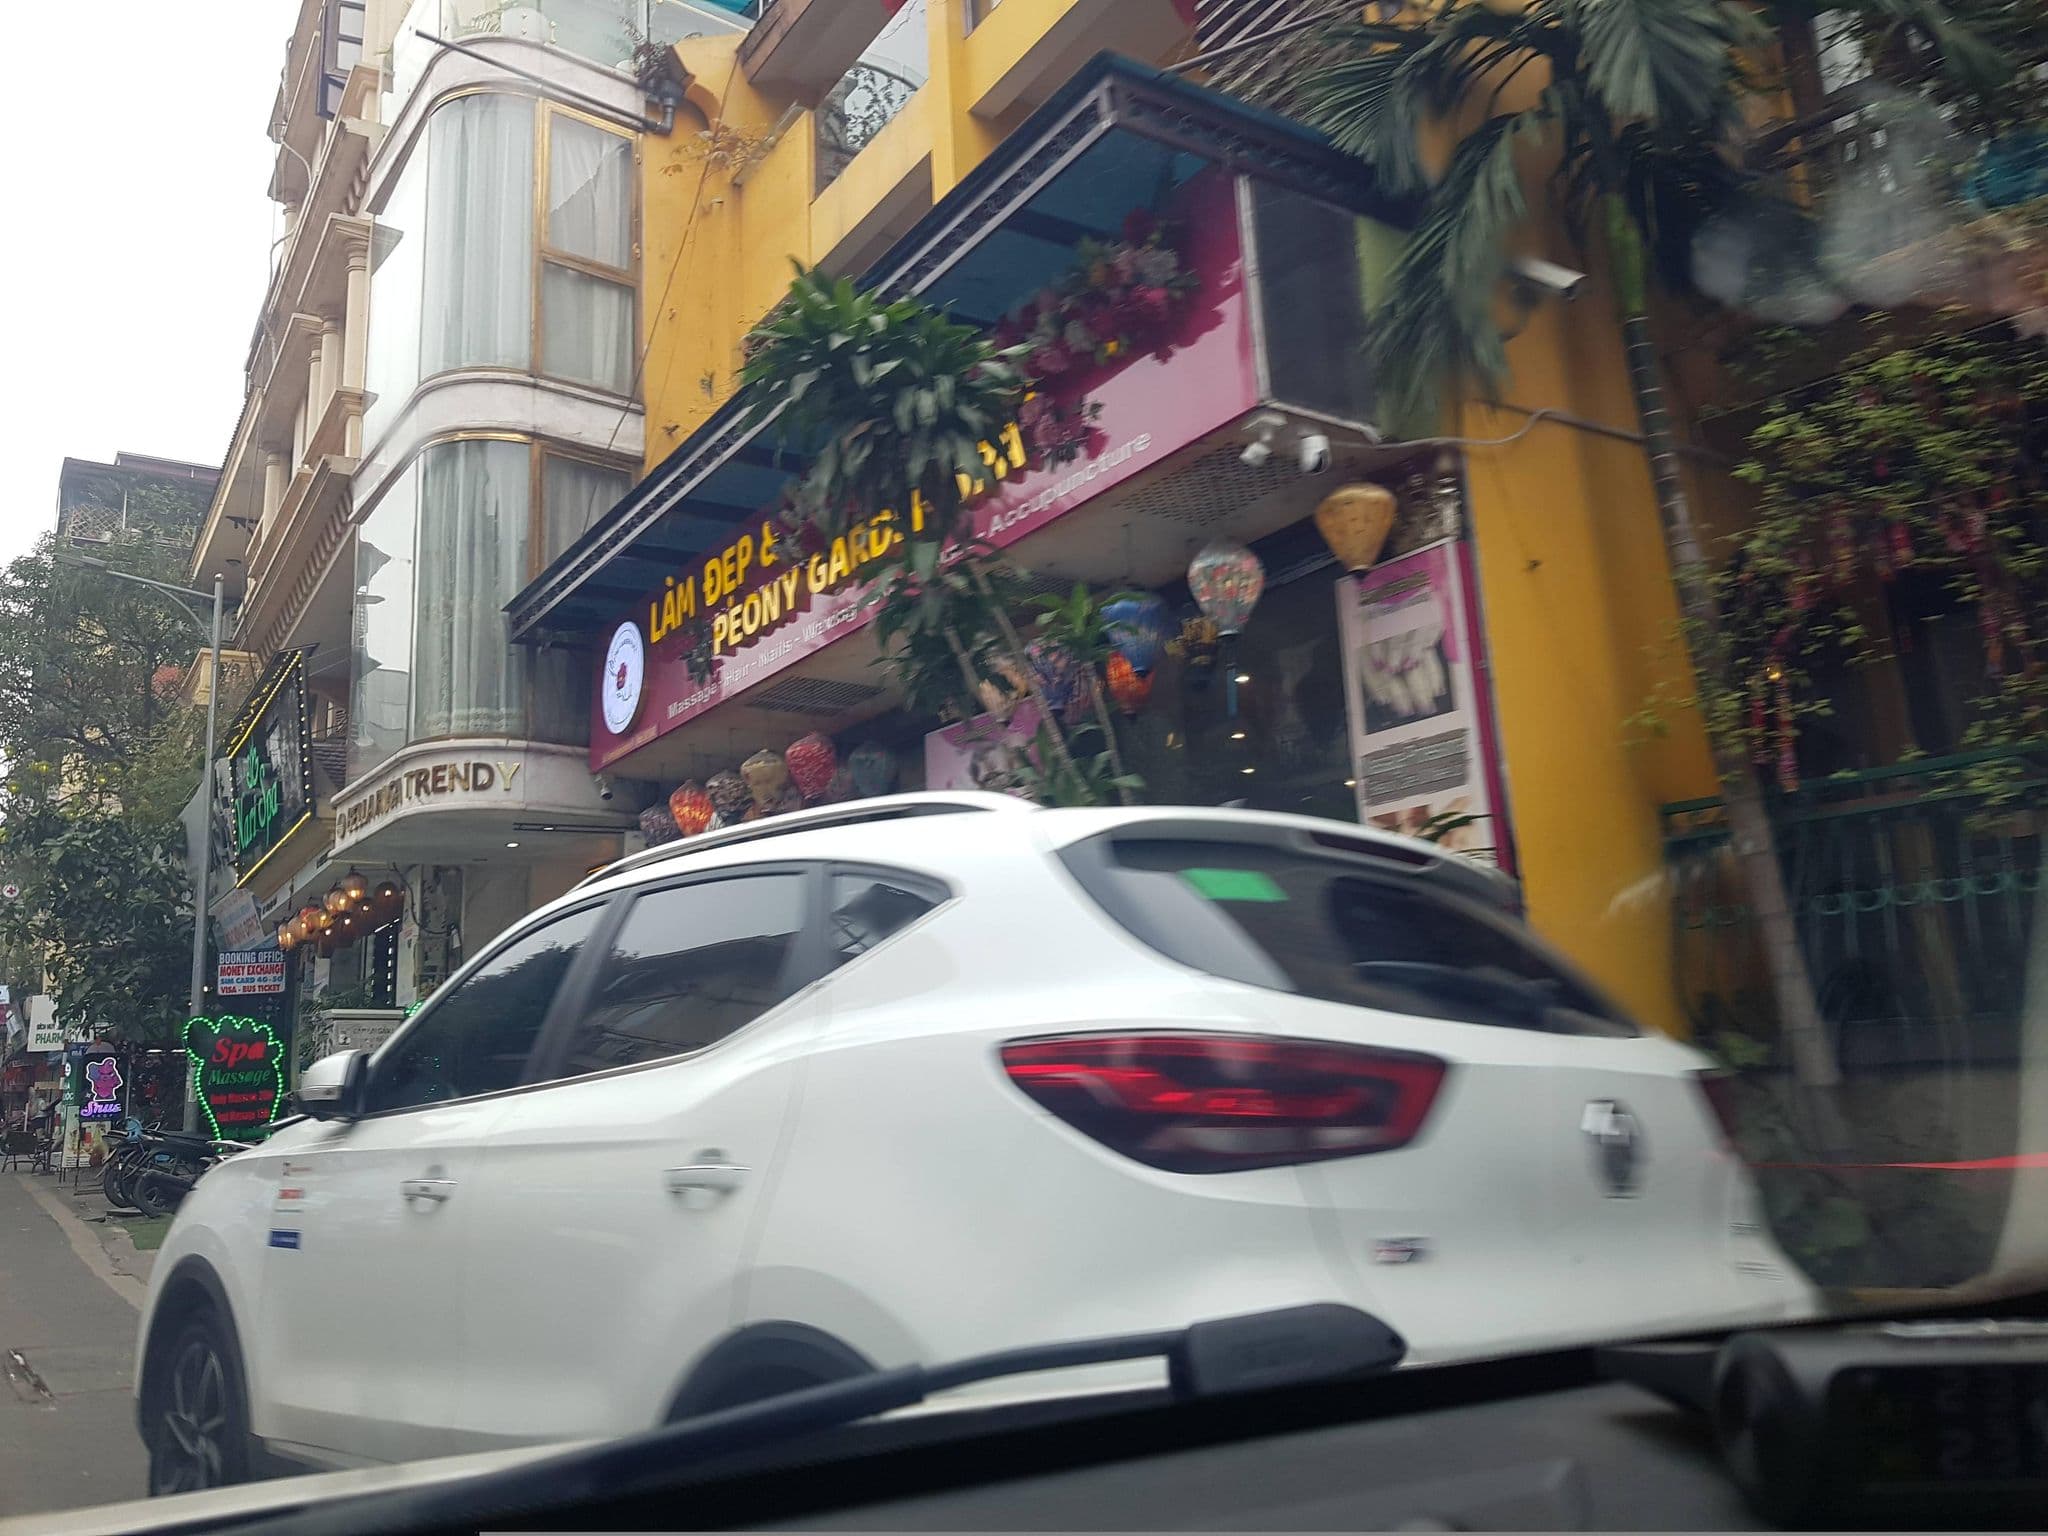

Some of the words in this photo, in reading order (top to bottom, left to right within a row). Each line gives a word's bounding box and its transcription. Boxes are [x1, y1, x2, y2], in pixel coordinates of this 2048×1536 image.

[713, 567, 800, 656] PEONY
[667, 681, 718, 719] Massage
[725, 663, 751, 687] Hair
[403, 761, 520, 801] TRENDY
[219, 952, 256, 964] BOOKING
[220, 965, 246, 977] MONEY
[236, 976, 256, 984] CARD
[221, 985, 238, 993] VISA
[243, 984, 256, 992] BUS
[258, 983, 281, 992] TICKET
[211, 1036, 267, 1068] Spa
[208, 1069, 271, 1087] Massage
